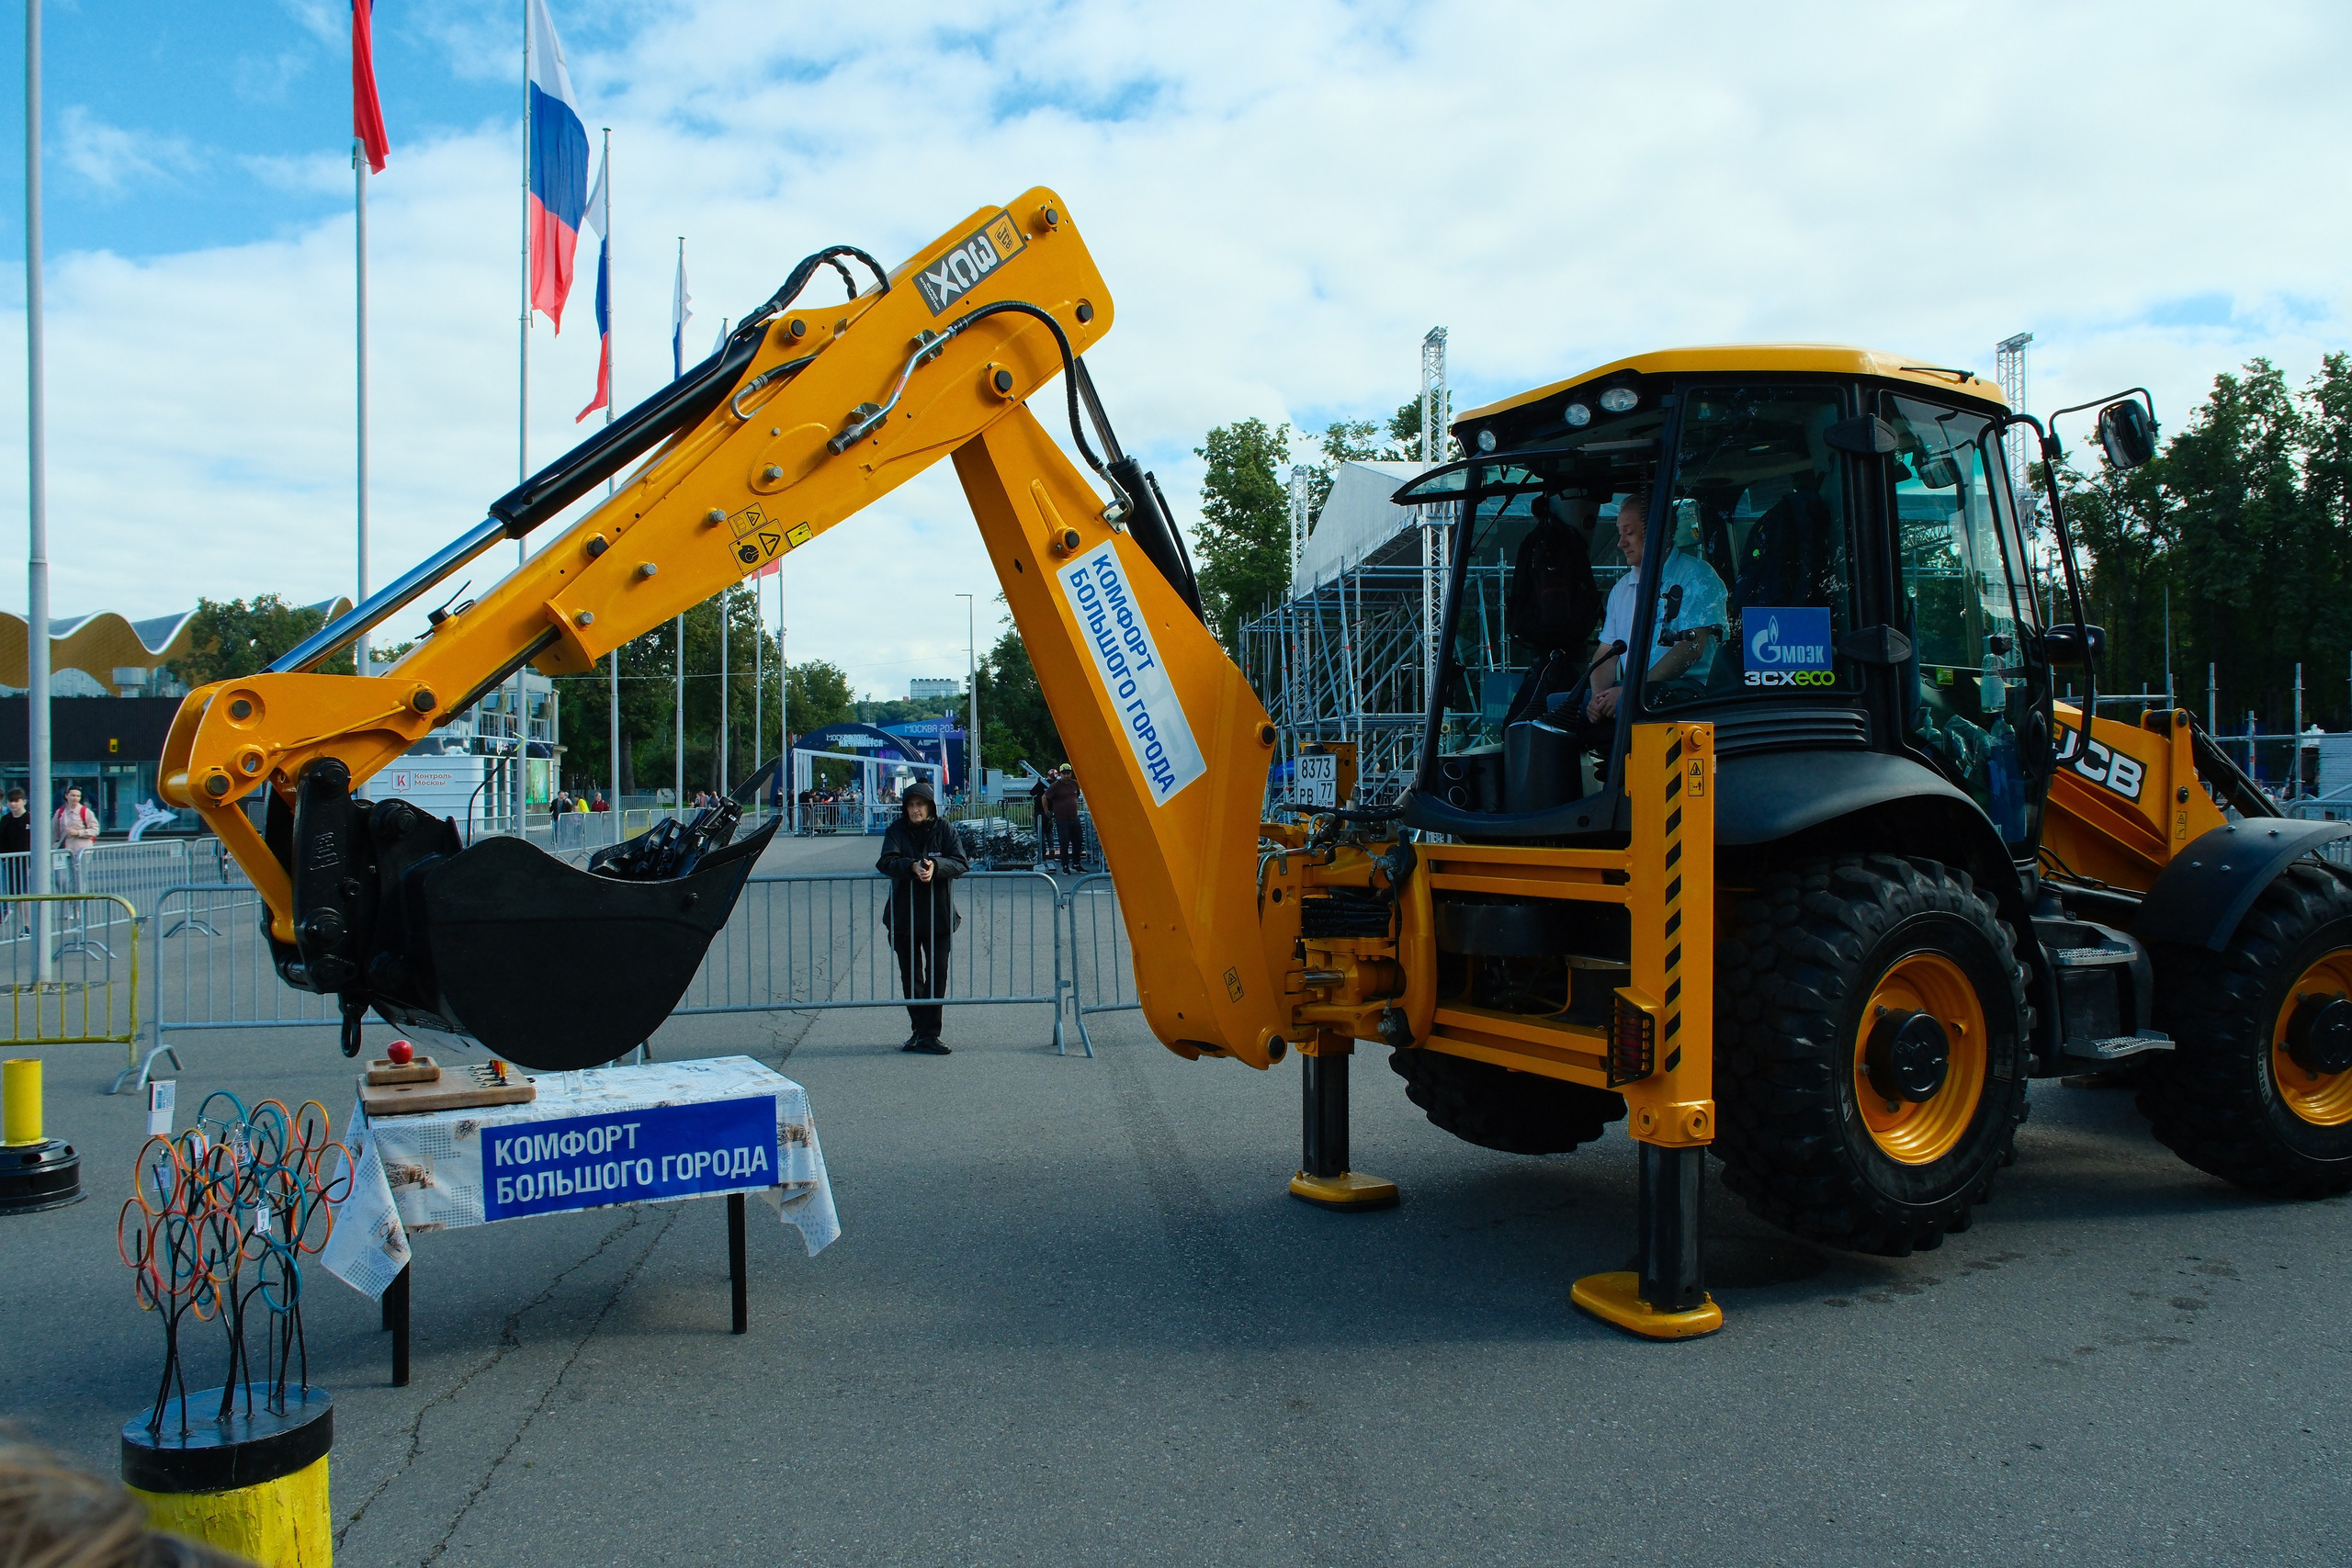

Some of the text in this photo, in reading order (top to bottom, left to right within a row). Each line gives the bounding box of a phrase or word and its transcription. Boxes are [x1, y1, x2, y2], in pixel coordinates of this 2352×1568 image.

[997, 227, 1012, 250] JCB
[924, 235, 998, 307] 3CX
[919, 276, 940, 310] SITEMASTER
[1092, 554, 1155, 671] КОМФОРТ
[1782, 646, 1825, 663] МОЭК
[1069, 568, 1175, 794] БОЛЬШОГО ГОРОДА
[905, 725, 938, 733] МОСКВА
[1301, 758, 1330, 779] 8373
[2052, 729, 2143, 798] JCB
[1321, 783, 1333, 798] 77
[495, 1122, 641, 1167] КОМФОРТ
[497, 1145, 769, 1204] БОЛЬШОГО ГОРОДА
